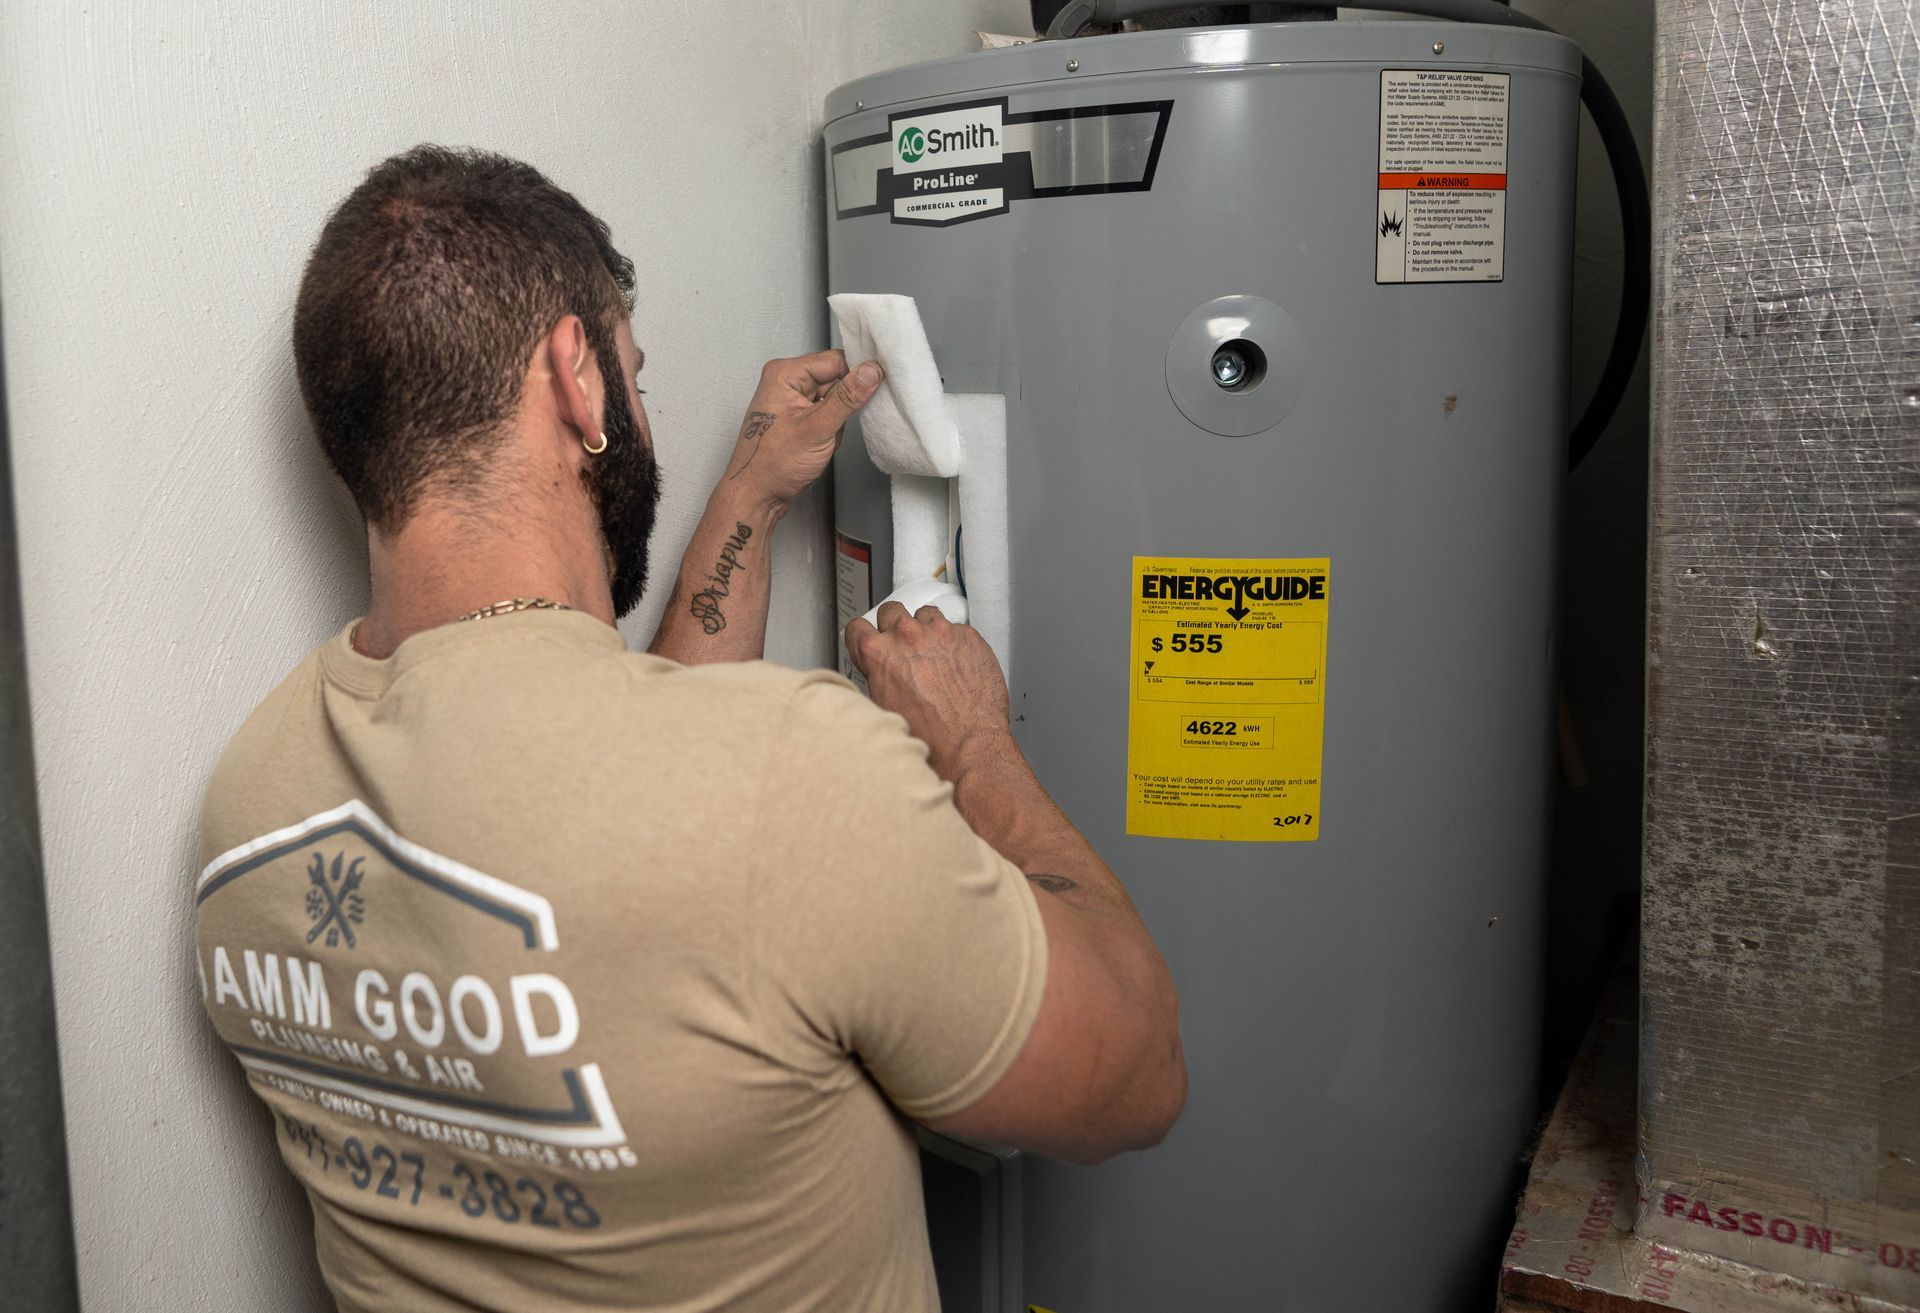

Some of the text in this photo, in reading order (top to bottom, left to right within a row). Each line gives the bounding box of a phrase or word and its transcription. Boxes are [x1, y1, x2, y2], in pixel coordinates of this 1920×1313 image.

[914, 172, 975, 190] ProLine
[1427, 178, 1469, 187] WARNING
[907, 198, 988, 212] COMMERCIAL GRADE
[1142, 574, 1325, 604] ENERGYGUIDE
[1214, 622, 1238, 630] Yearly
[1239, 622, 1265, 630] Energy
[1152, 634, 1223, 653] $ 555
[1186, 720, 1237, 735] 4622
[1133, 773, 1151, 782] Your
[1273, 814, 1312, 827] 2017
[199, 946, 580, 1056] AMM GOOD
[250, 1018, 484, 1093] PLUMBING & AIR
[320, 1091, 375, 1122] OWNED
[379, 1108, 393, 1127] &
[394, 1112, 490, 1153] OPERATED
[495, 1128, 558, 1163] SINCE
[1578, 1179, 1622, 1242] FASSON
[1662, 1193, 1834, 1254] FASSON
